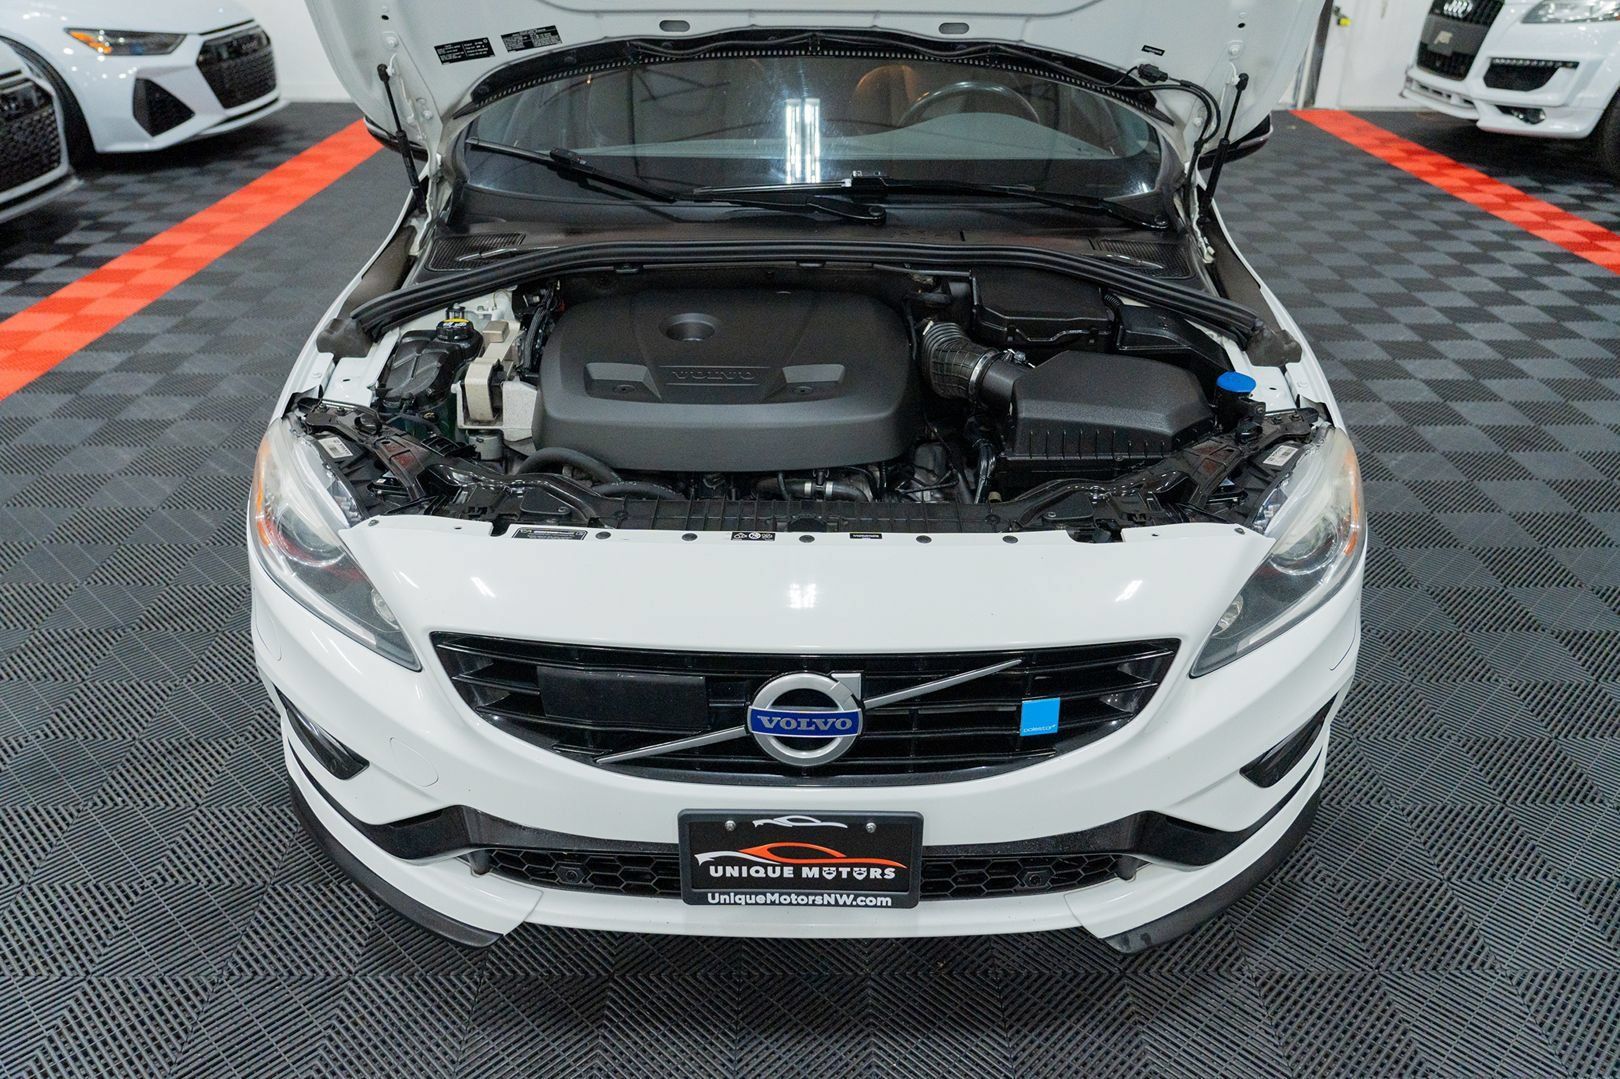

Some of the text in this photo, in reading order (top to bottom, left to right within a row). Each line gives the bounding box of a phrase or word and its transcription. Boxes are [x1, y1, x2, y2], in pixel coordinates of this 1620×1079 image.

[672, 371, 755, 380] VOLVO
[757, 715, 853, 731] VOLVO
[708, 865, 896, 881] UNIQUE MOTORS
[707, 892, 892, 907] UniqueMotorsNW.com
